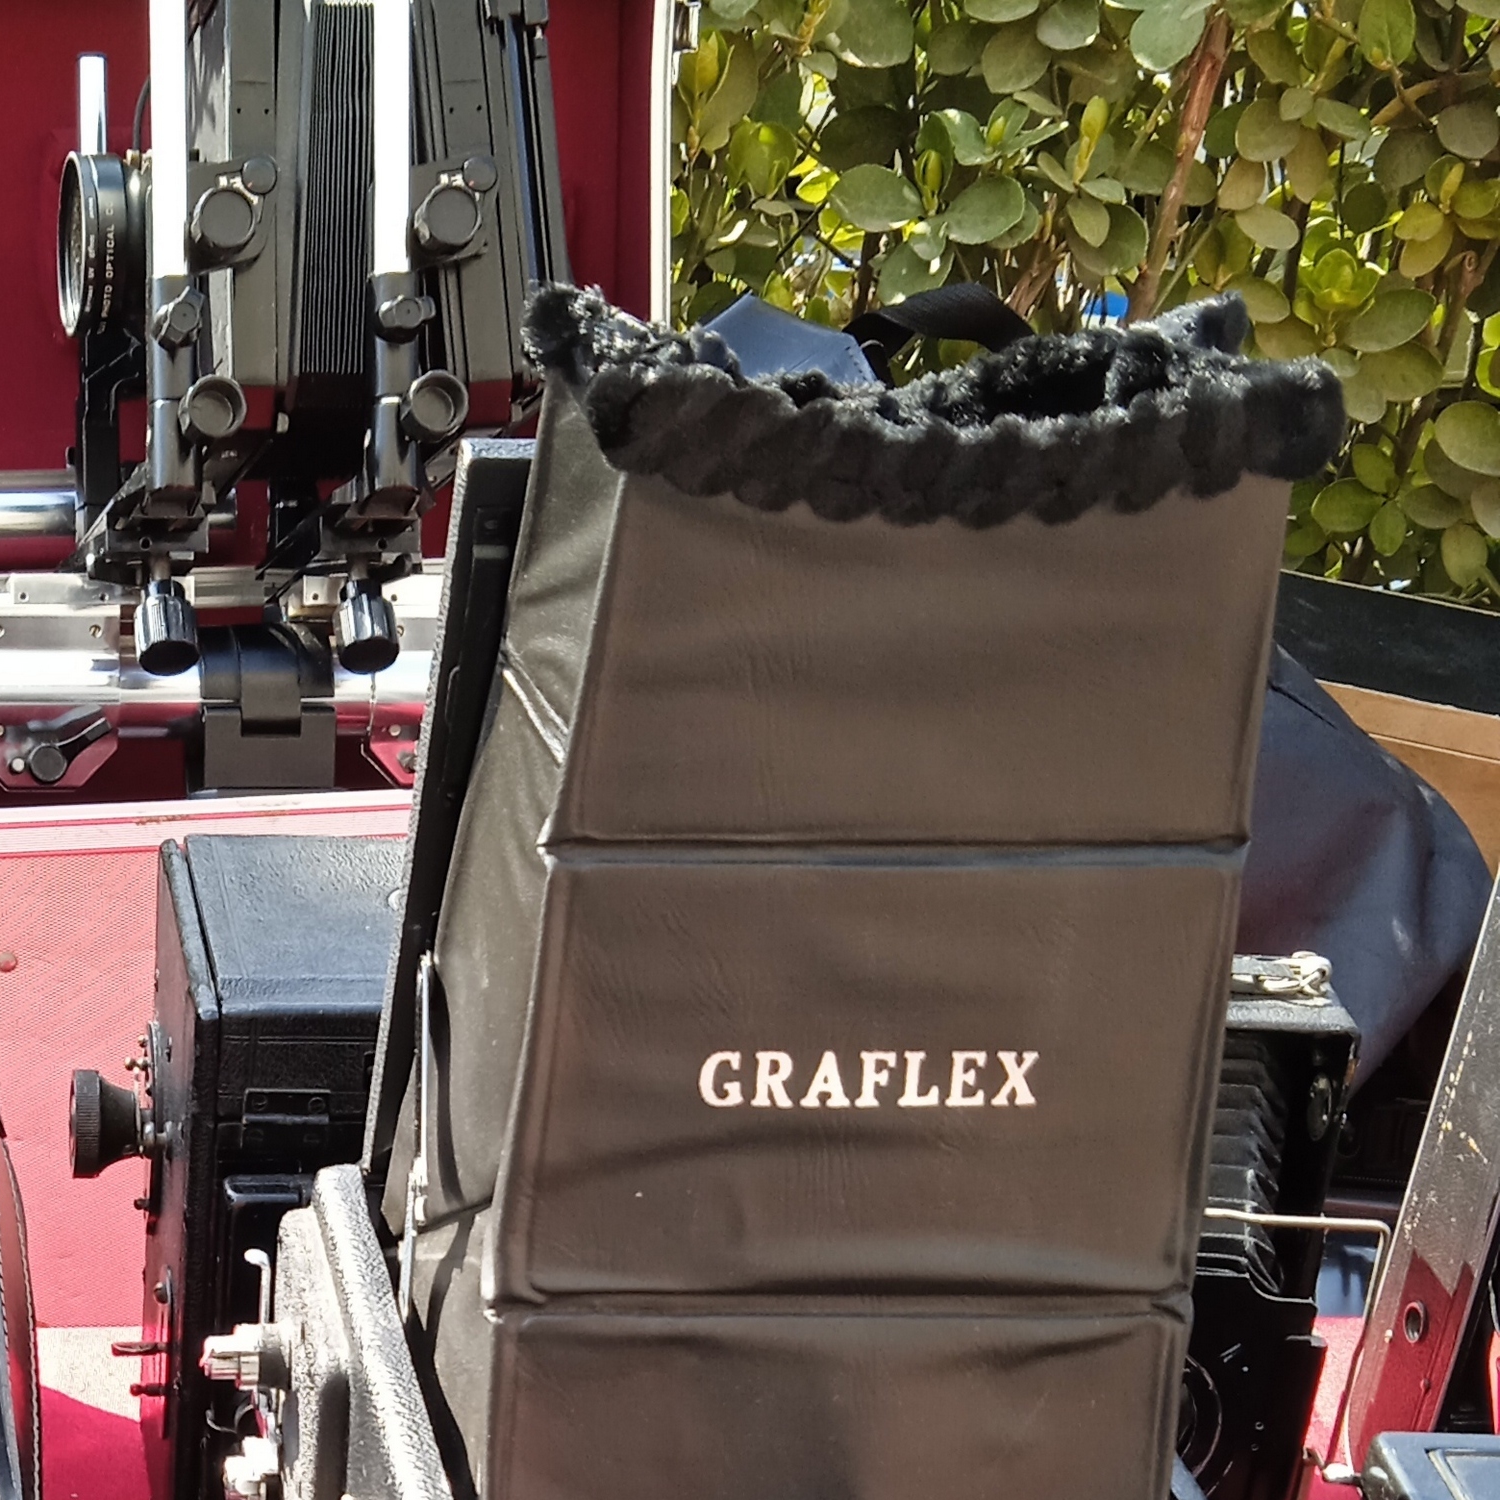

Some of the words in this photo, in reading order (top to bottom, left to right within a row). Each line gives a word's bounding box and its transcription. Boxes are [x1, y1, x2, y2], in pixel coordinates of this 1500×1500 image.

[105, 224, 115, 279] OPTICAL
[101, 284, 113, 318] PHOTO
[698, 1050, 1040, 1109] GRAFLEX
